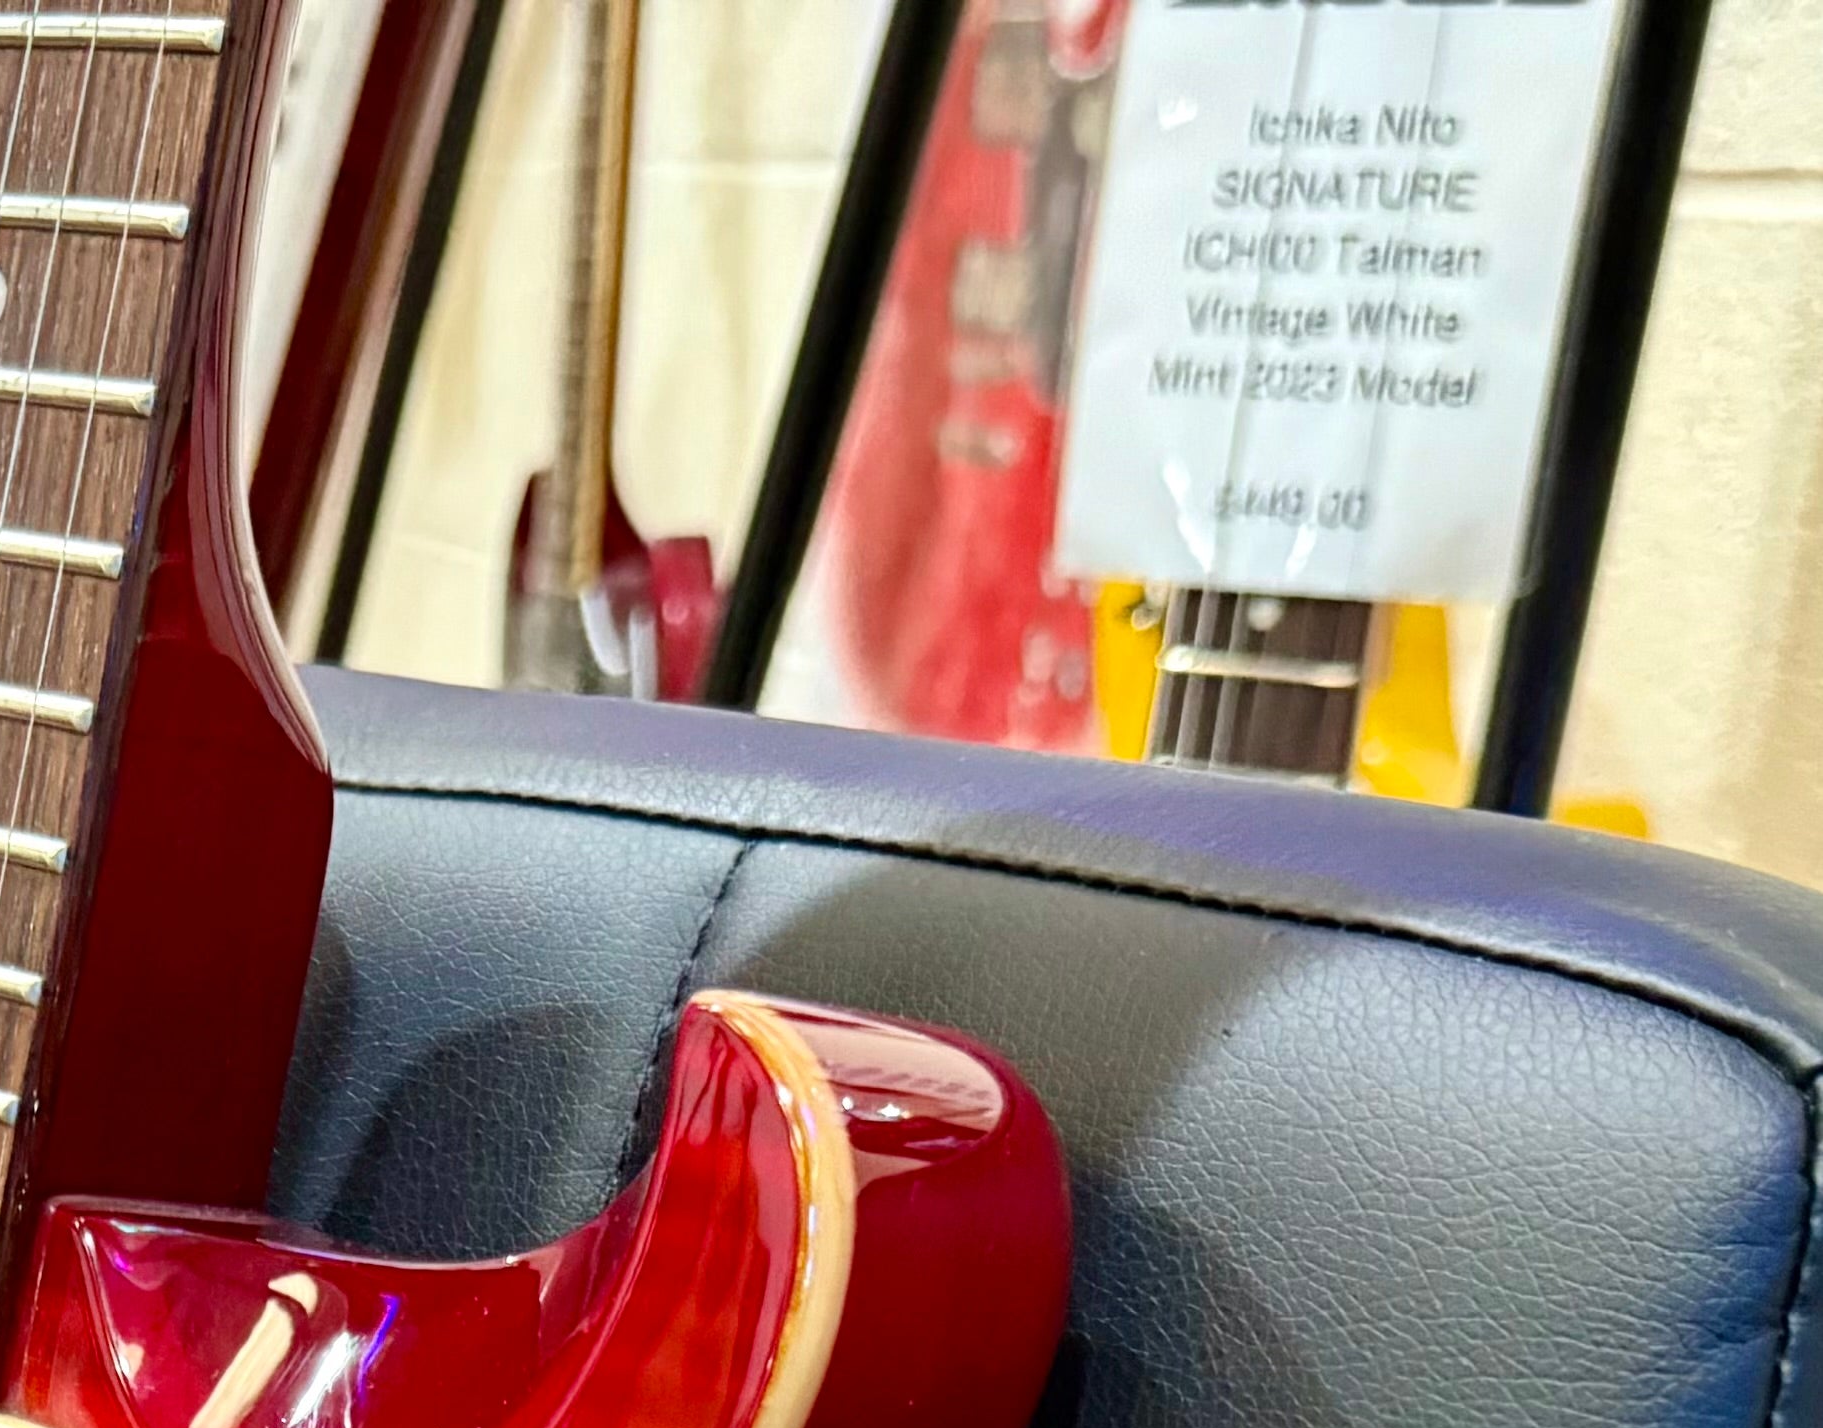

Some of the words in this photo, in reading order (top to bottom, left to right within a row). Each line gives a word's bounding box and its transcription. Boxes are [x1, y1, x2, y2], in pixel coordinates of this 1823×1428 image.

[1249, 104, 1362, 146] Ichika
[1212, 168, 1481, 213] SIGNATURE
[1336, 233, 1490, 278] Talman
[1185, 293, 1331, 344] Vintage
[1346, 300, 1464, 343] White
[1148, 353, 1235, 398] Mint
[1351, 365, 1482, 408] Model
